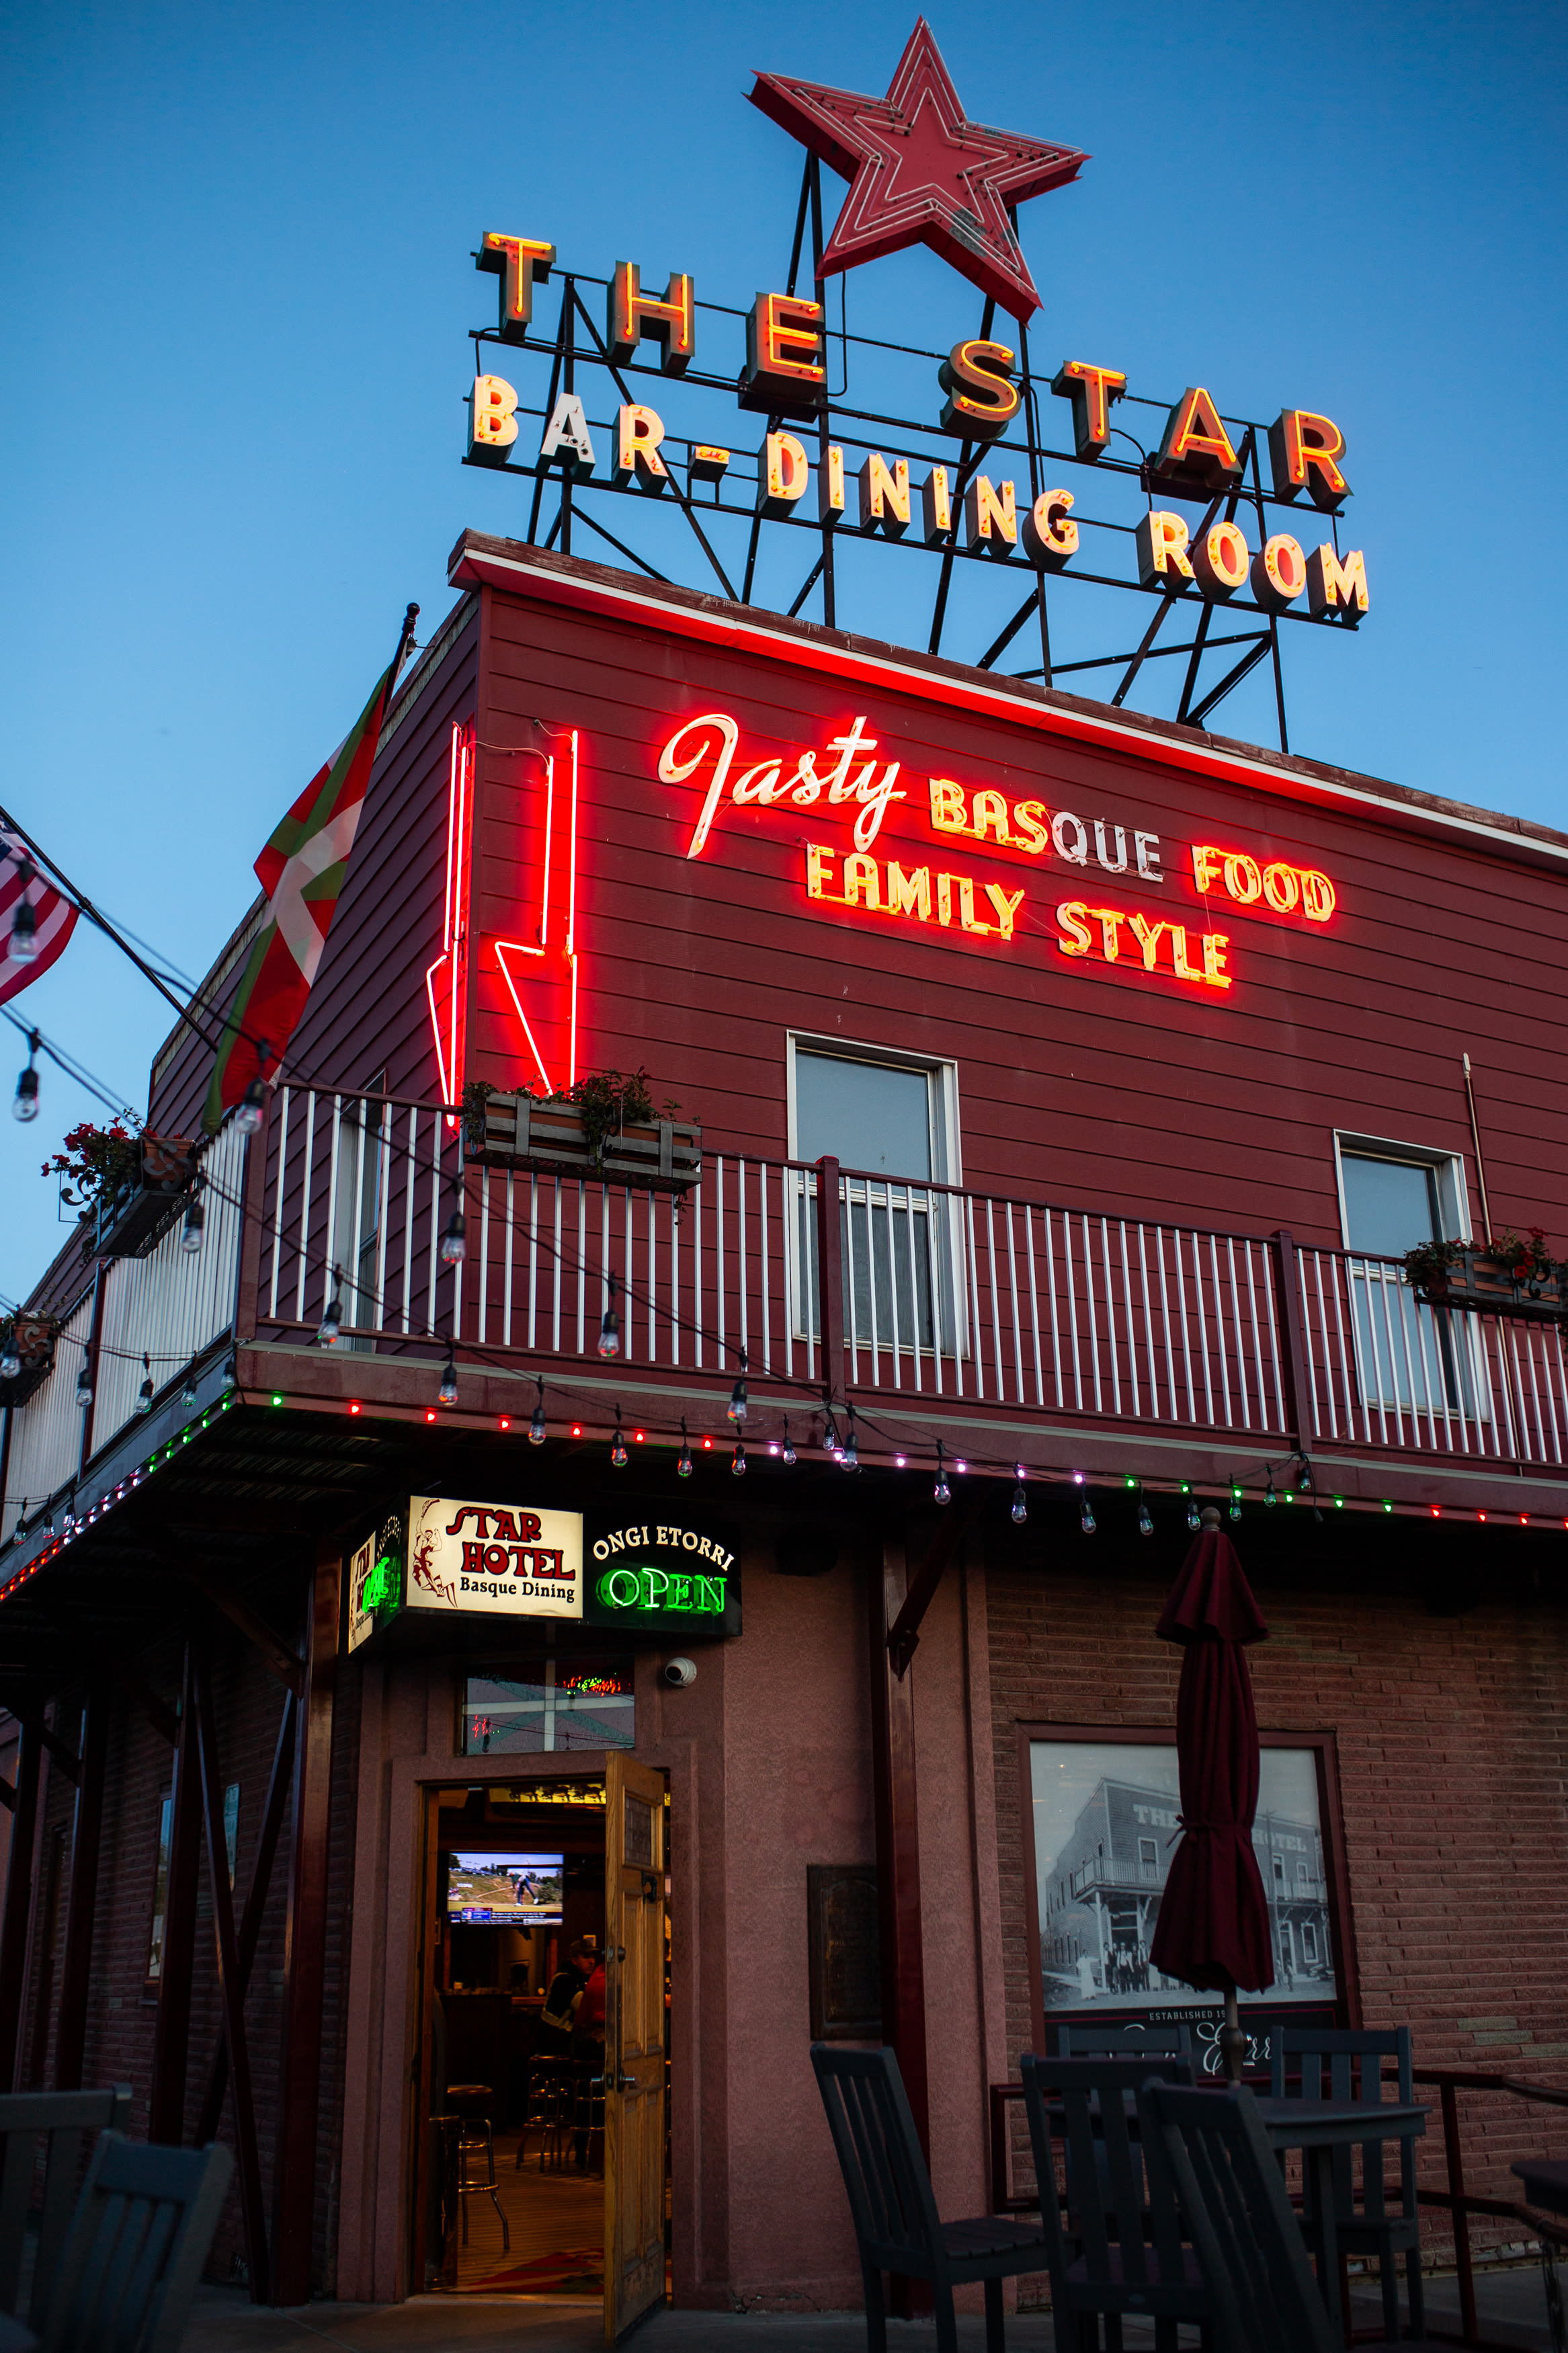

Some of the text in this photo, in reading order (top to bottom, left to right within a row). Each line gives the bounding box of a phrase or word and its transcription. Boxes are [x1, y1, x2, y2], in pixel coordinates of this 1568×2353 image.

[477, 231, 1354, 499] THE STAR
[1145, 510, 1369, 614] ROOM
[657, 713, 1336, 922] Tasty BASQUE FOOD
[806, 843, 1231, 989] FAMILY STYLE
[446, 1506, 543, 1542] STAR
[460, 1542, 576, 1581] HOTEL
[593, 1525, 735, 1572] ONGI ETORRI
[460, 1577, 575, 1604] Basque Dining
[602, 1567, 728, 1613] OPEN
[1149, 2009, 1213, 2022] ESTABLISHED
